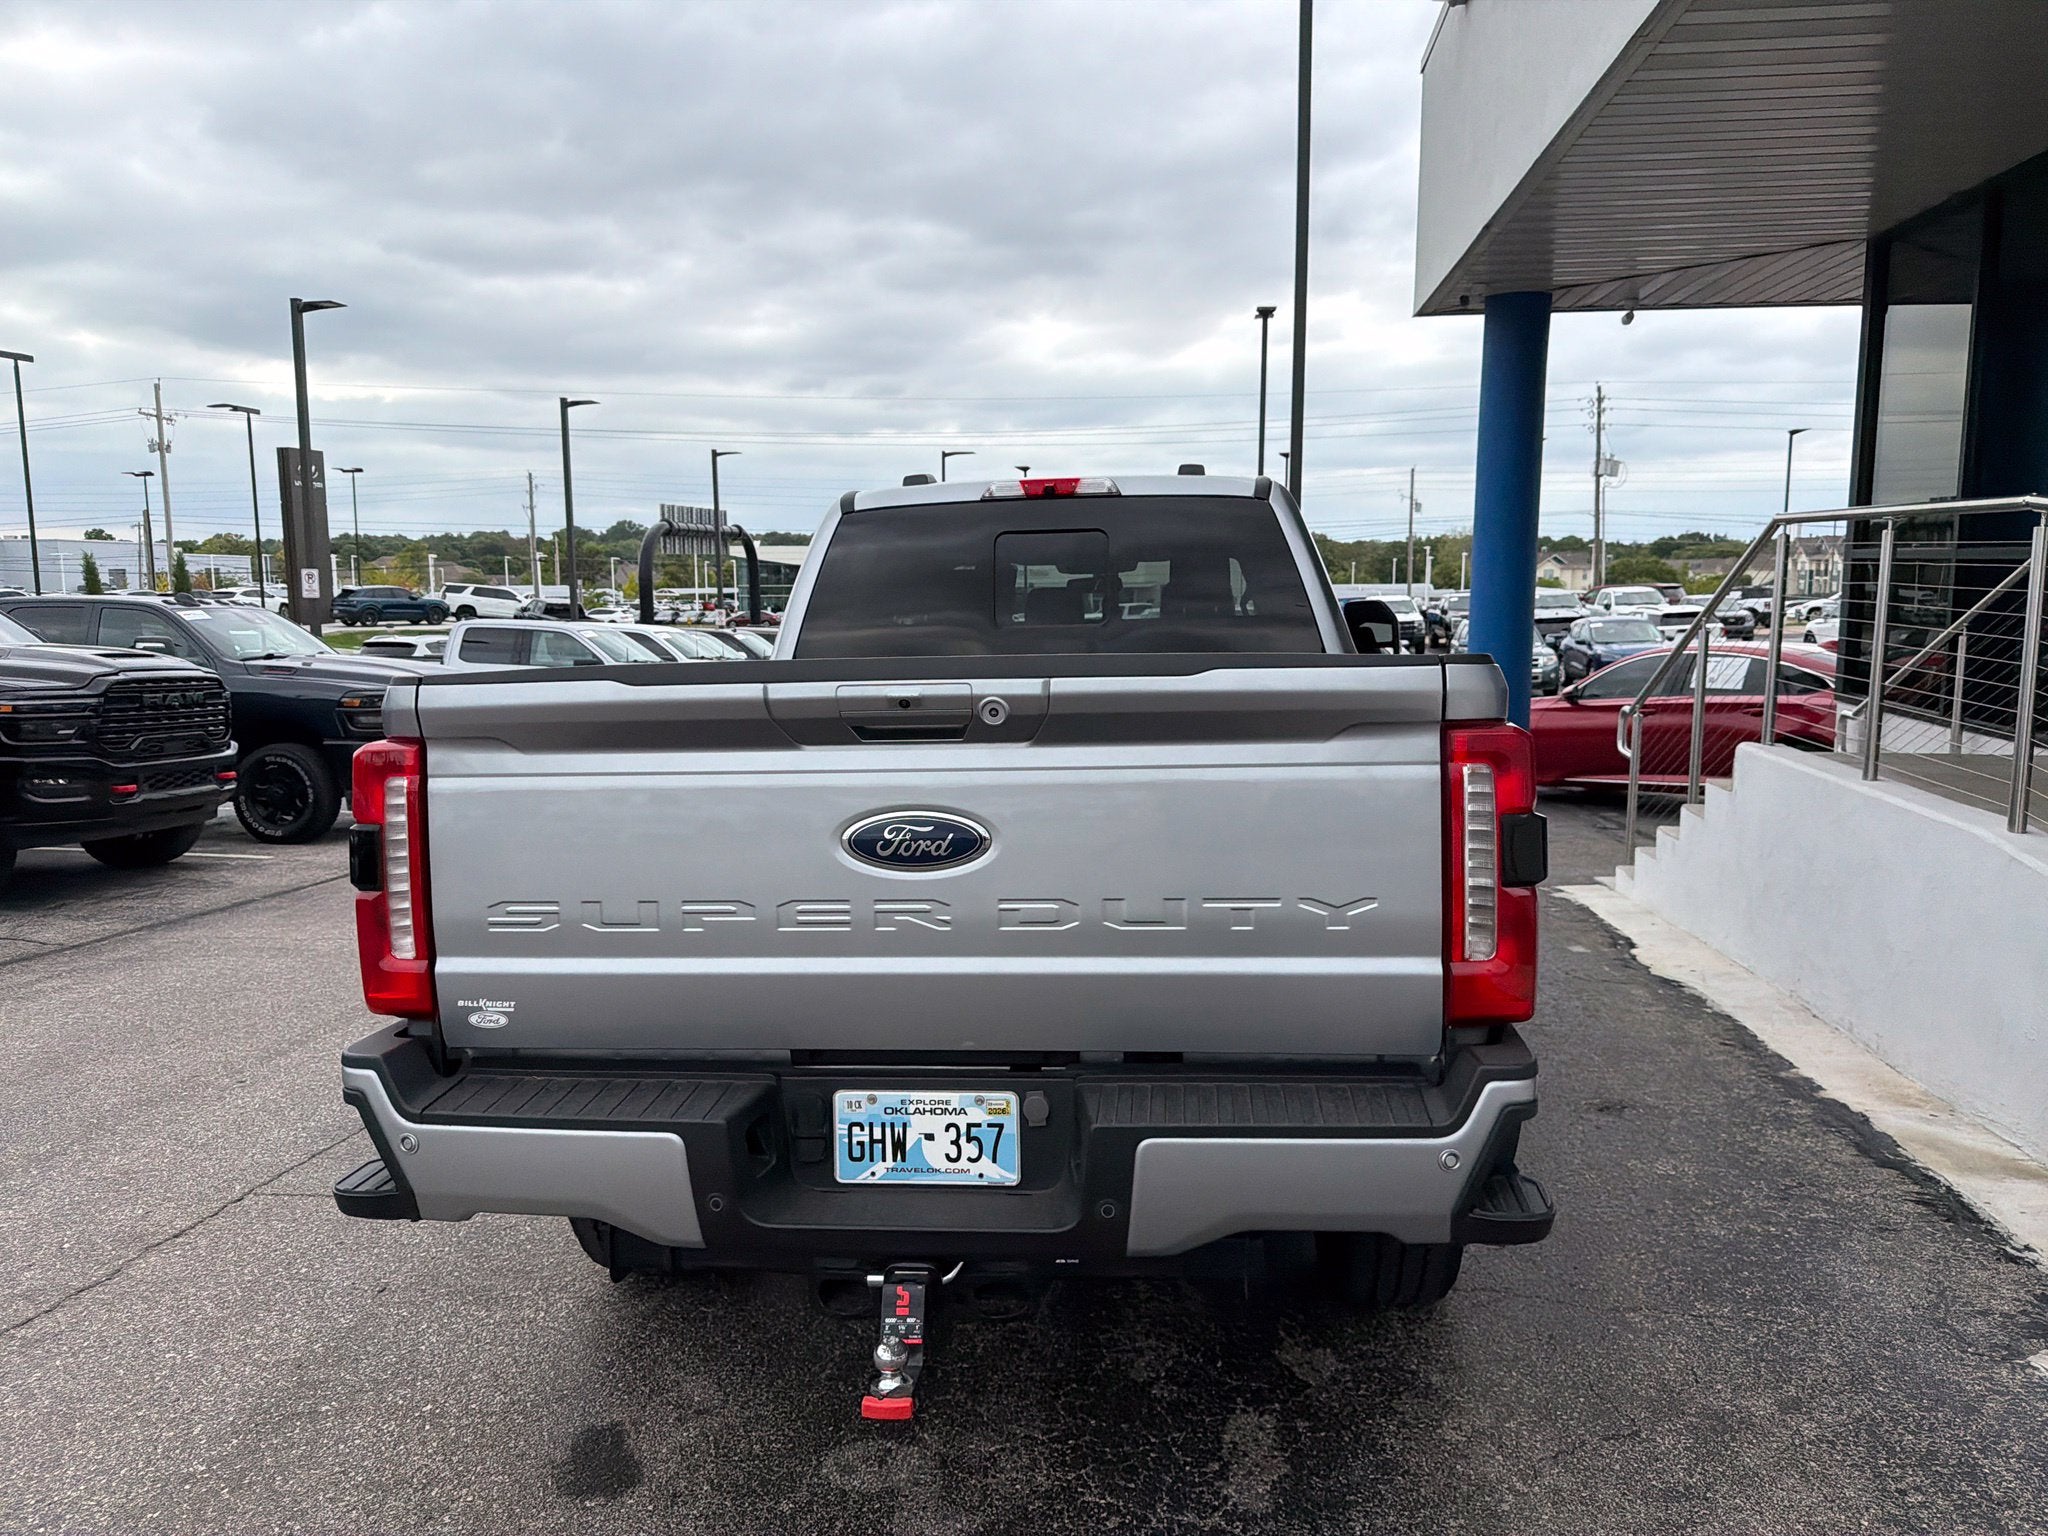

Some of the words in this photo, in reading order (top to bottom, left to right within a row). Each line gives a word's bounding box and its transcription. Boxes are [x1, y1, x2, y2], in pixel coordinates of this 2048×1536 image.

[142, 691, 205, 706] RAM
[876, 824, 954, 857] Ford
[487, 898, 952, 932] SUPER
[997, 896, 1379, 931] DUTY
[476, 1014, 501, 1025] Ford
[883, 1106, 968, 1116] OKLAHOMA
[988, 1107, 1007, 1115] 2026
[848, 1122, 907, 1163] GHW
[944, 1122, 1005, 1164] 357
